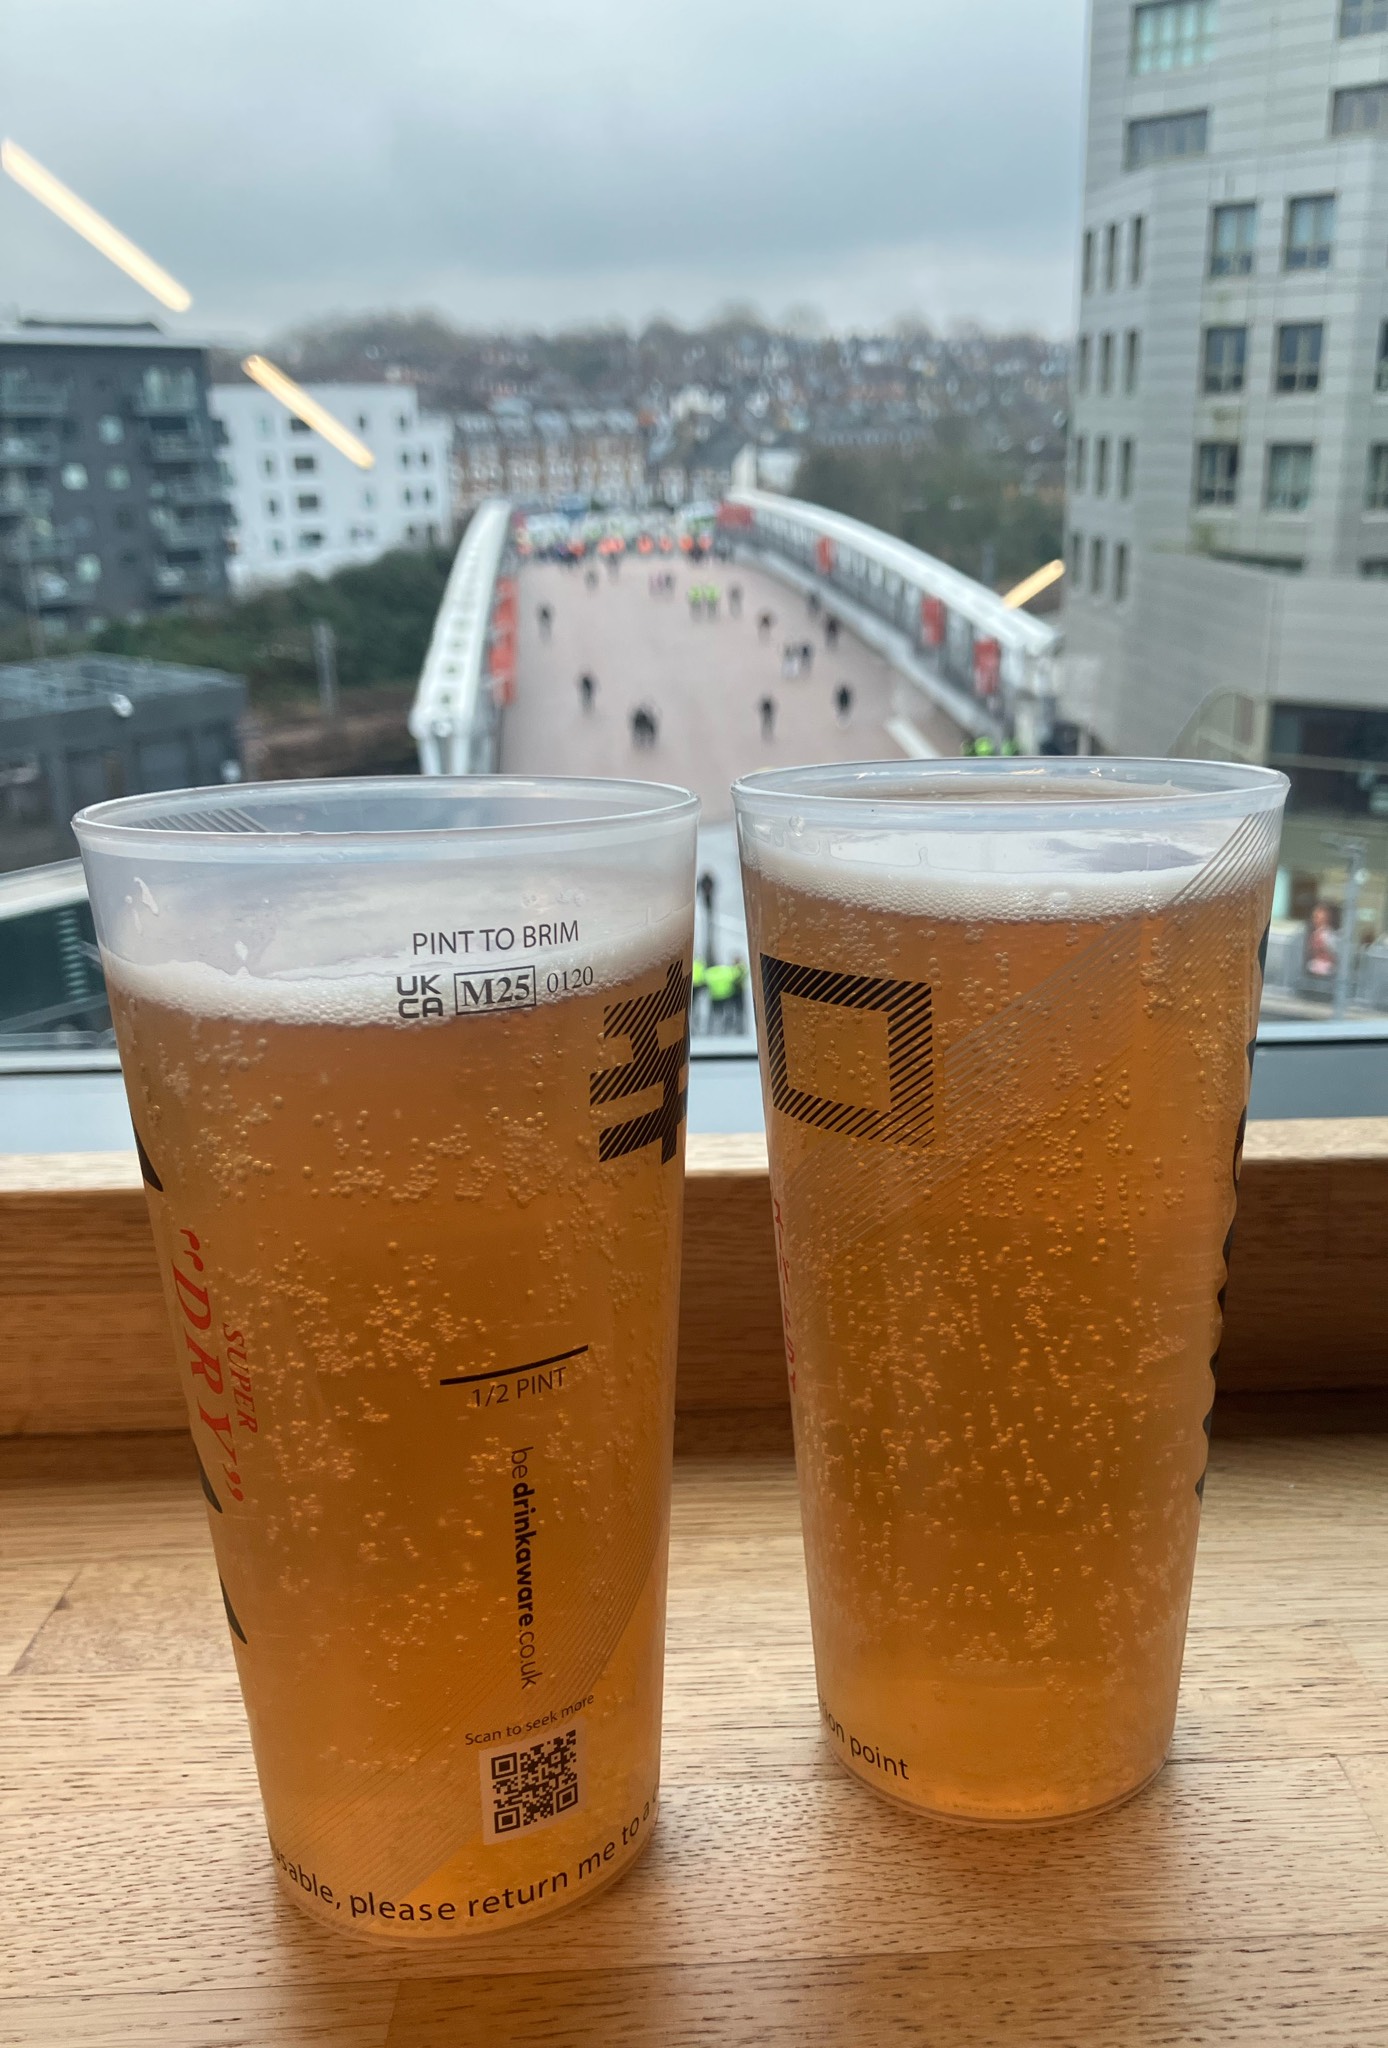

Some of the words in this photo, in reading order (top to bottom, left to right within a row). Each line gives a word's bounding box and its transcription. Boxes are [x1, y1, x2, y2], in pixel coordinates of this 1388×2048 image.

[412, 930, 475, 955] PINT
[480, 927, 515, 951] TO
[523, 920, 579, 948] BRIM
[460, 974, 531, 1006] M25
[546, 966, 594, 993] 0120
[222, 1322, 259, 1434] SUPER
[472, 1384, 509, 1407] 1/2
[517, 1366, 567, 1399] PINT
[465, 1730, 501, 1745] Scan
[506, 1725, 522, 1736] to
[526, 1711, 558, 1732] seek
[561, 1694, 594, 1718] more
[850, 1735, 909, 1780] point
[350, 1892, 456, 1921] please
[468, 1871, 568, 1917] return
[578, 1842, 616, 1880] me
[621, 1817, 640, 1845] to
